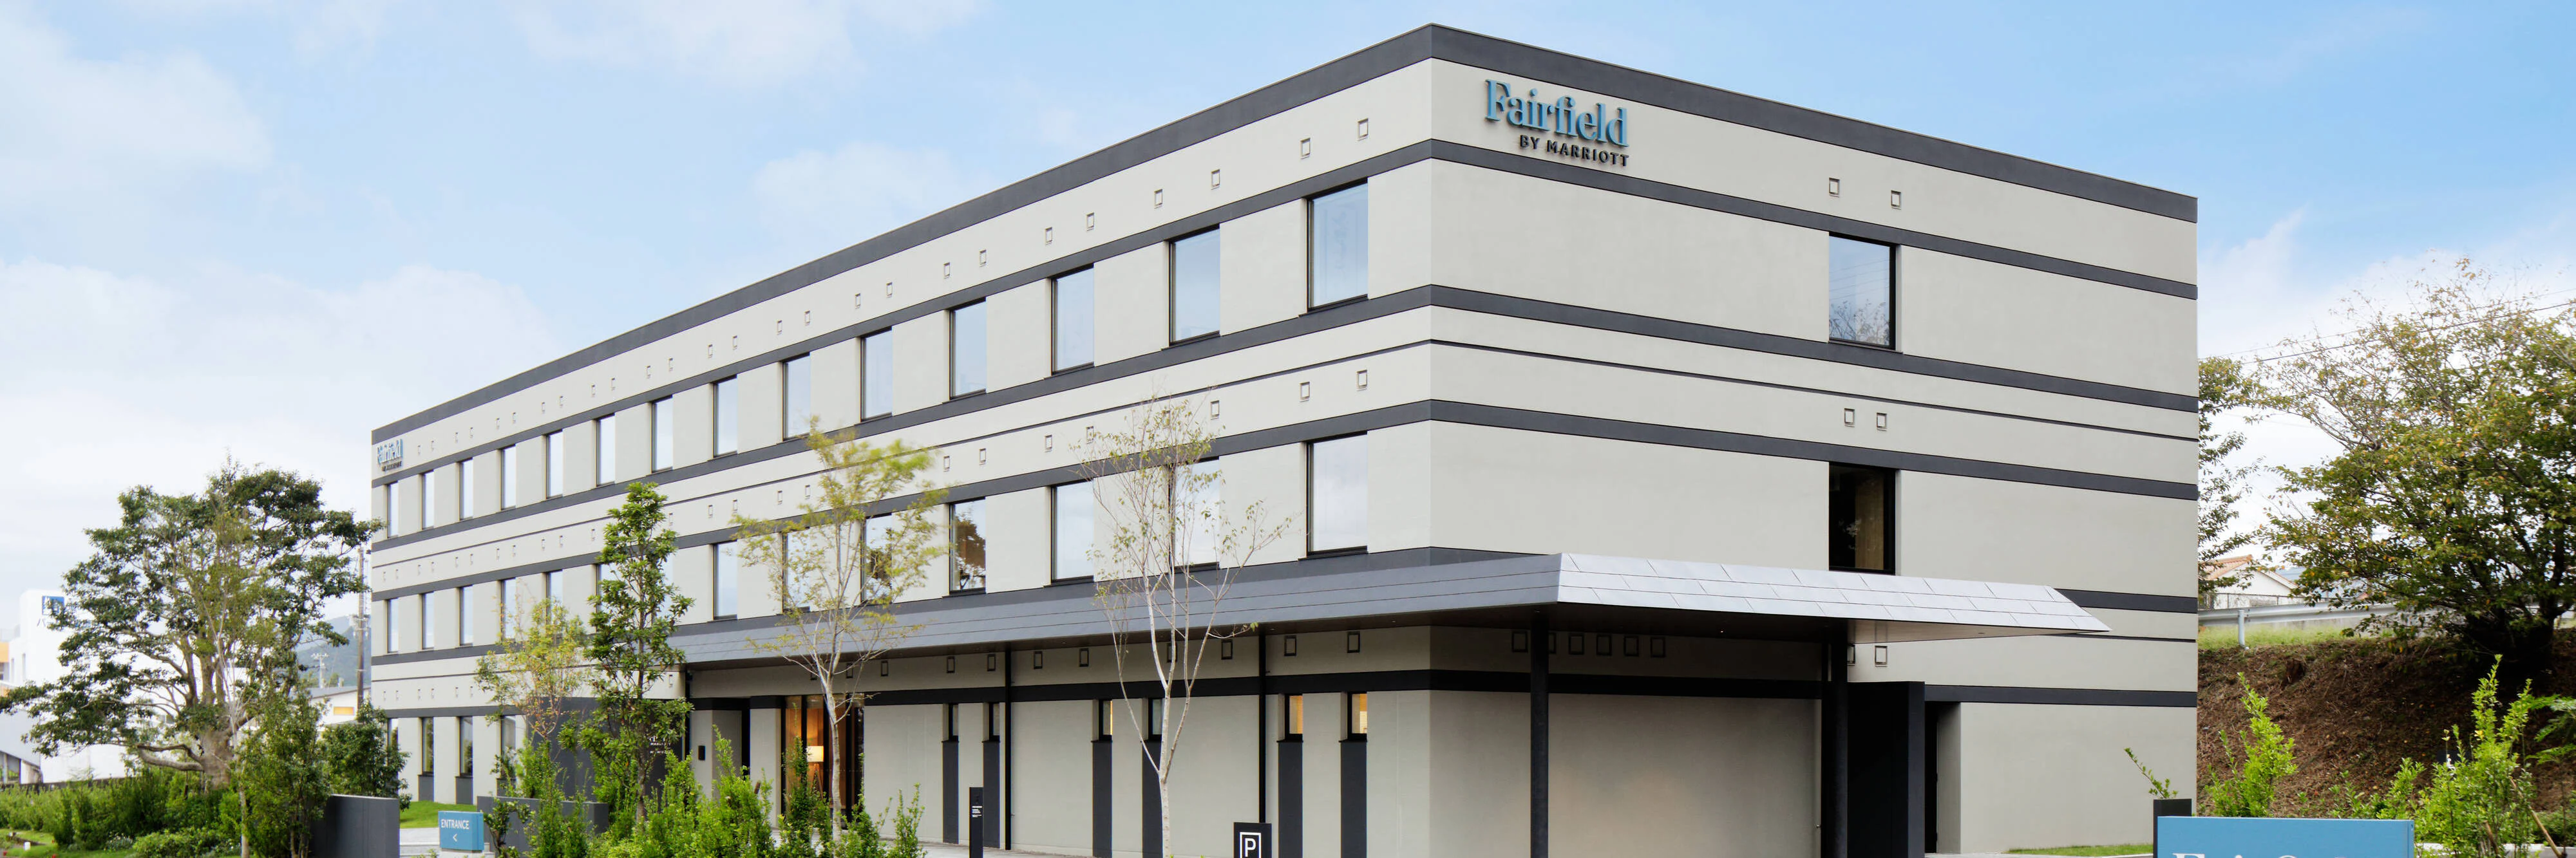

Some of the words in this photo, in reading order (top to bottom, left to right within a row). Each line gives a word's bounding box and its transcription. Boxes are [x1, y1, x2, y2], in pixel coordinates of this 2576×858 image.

[1485, 79, 1629, 147] Fairfield
[1520, 135, 1540, 149] BY
[1547, 140, 1629, 167] MARRIOTT
[441, 819, 469, 830] ENTRANCE
[1245, 837, 1256, 857] P
